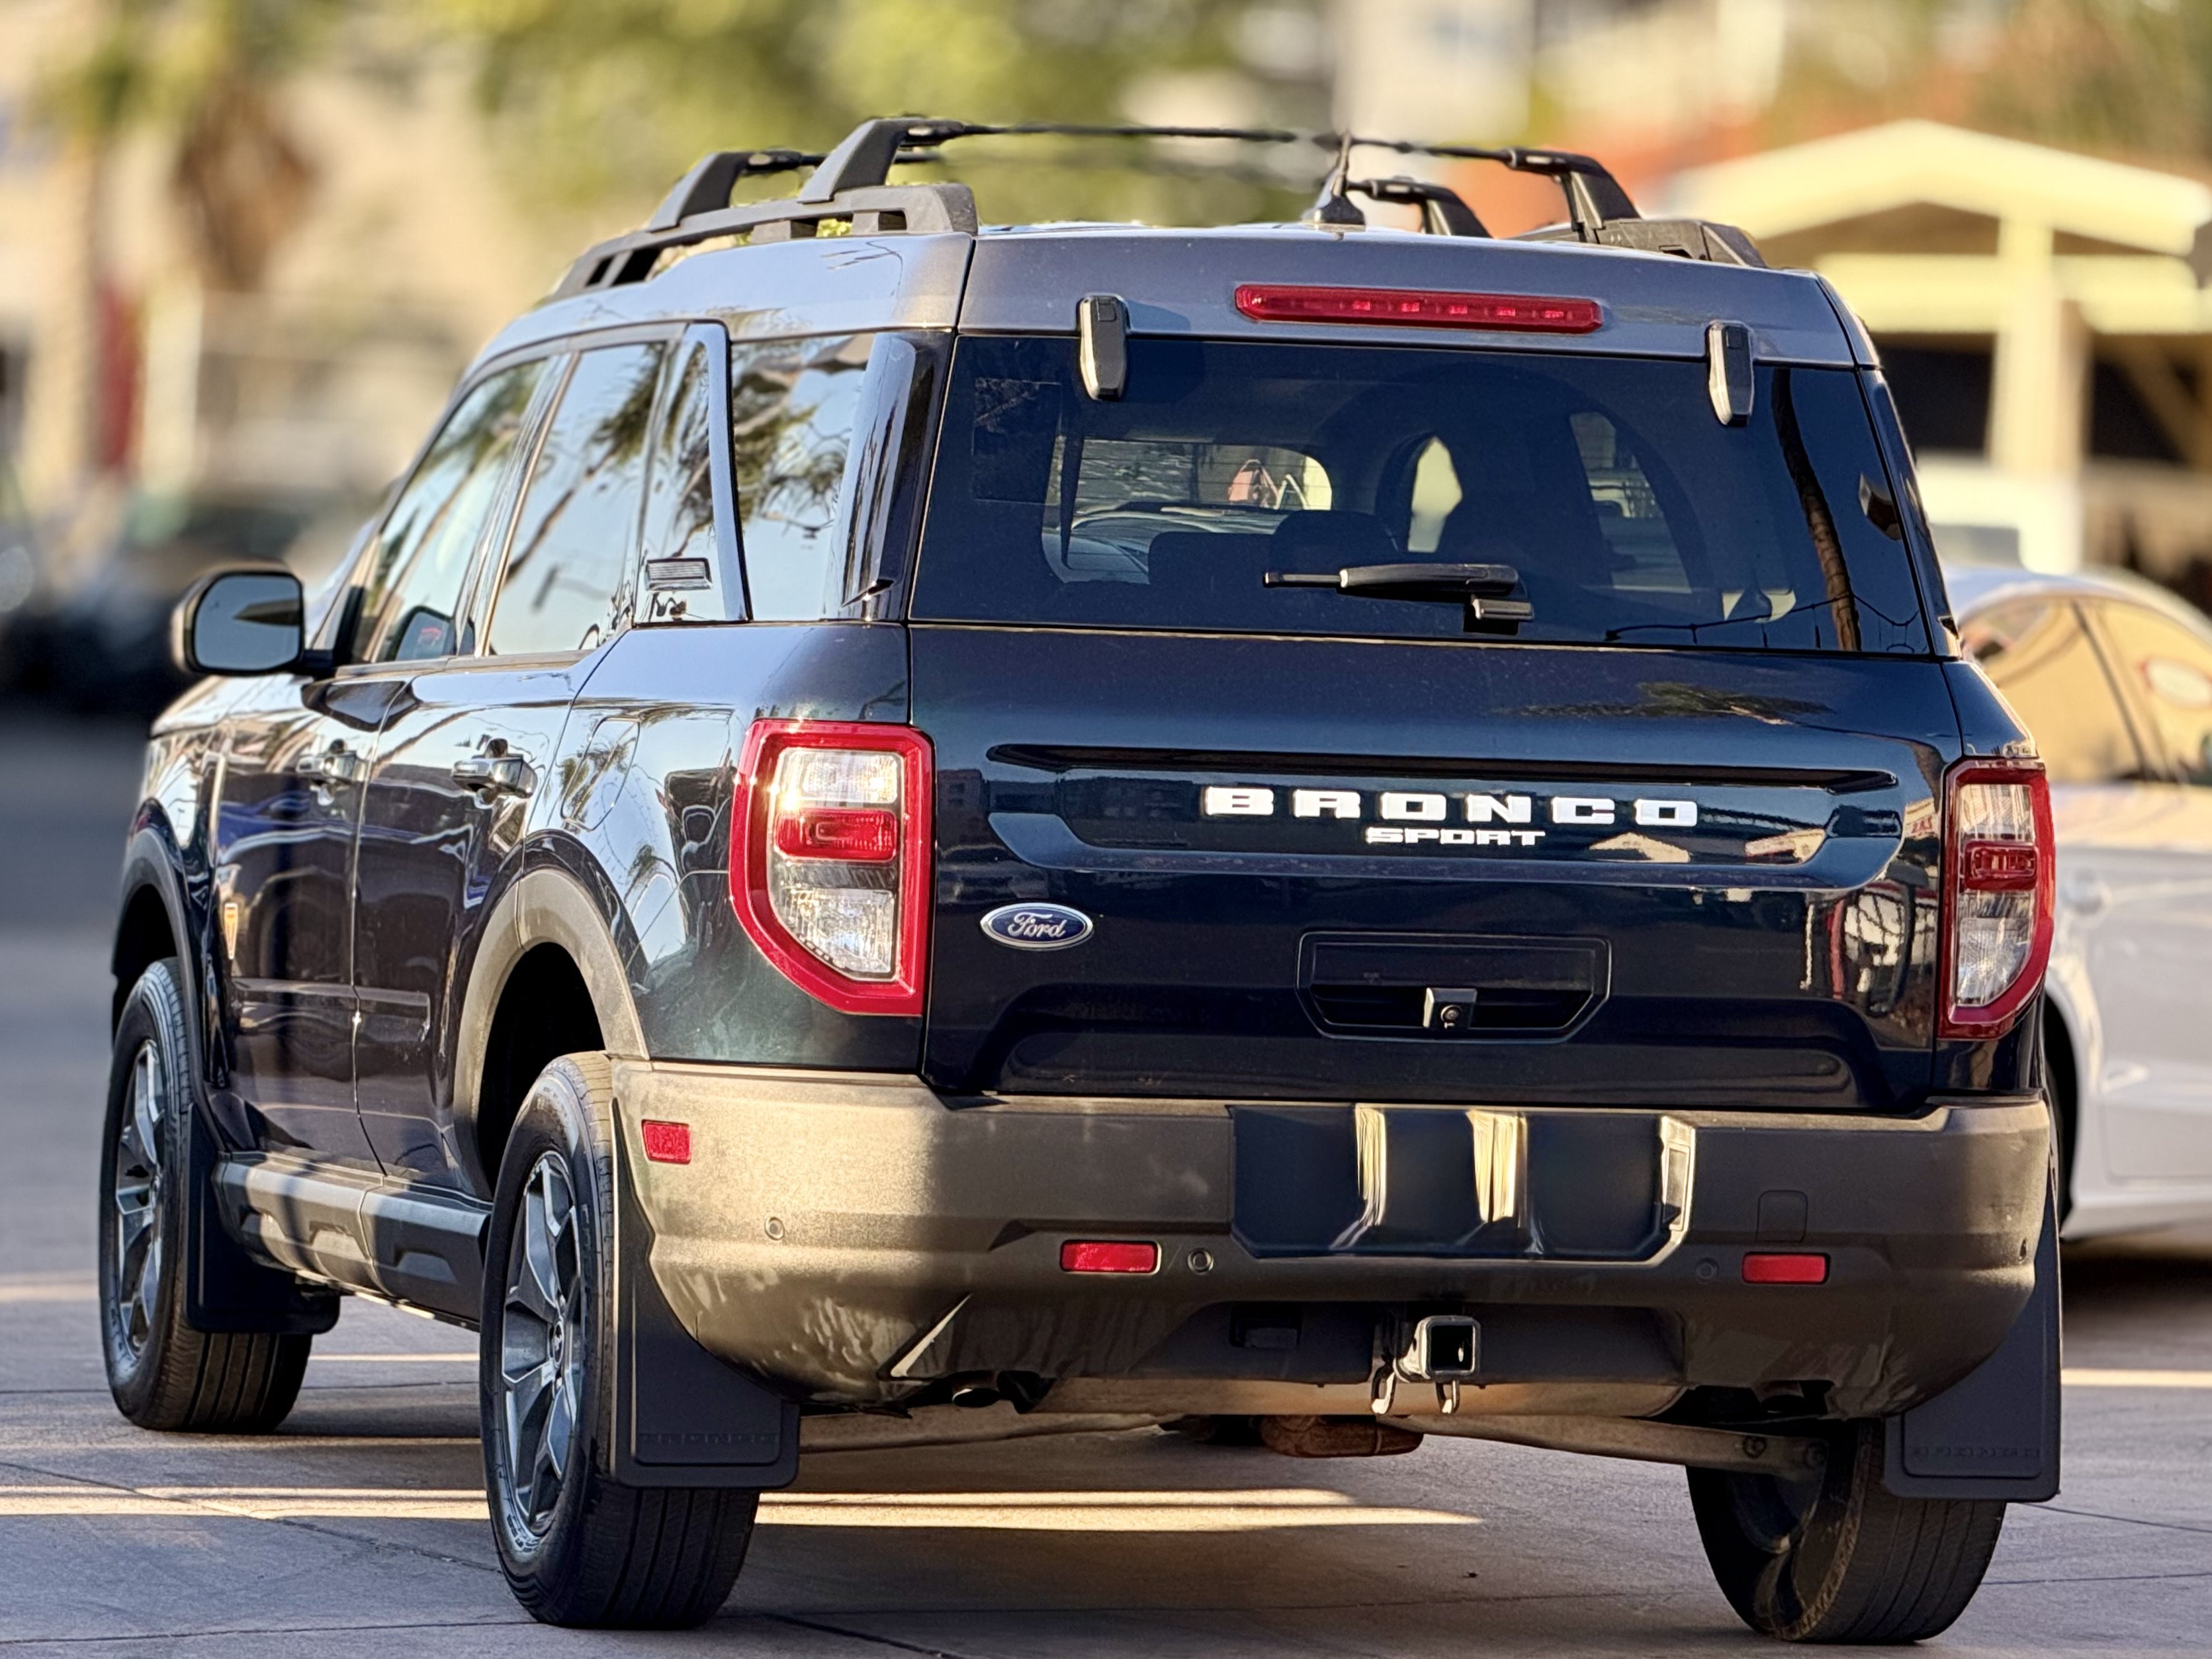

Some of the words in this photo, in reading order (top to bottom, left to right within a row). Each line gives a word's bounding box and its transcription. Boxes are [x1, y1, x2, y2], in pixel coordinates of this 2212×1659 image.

[1204, 785, 1699, 827] BRONCO
[1365, 826, 1546, 846] SPORT
[1007, 911, 1068, 938] Ford
